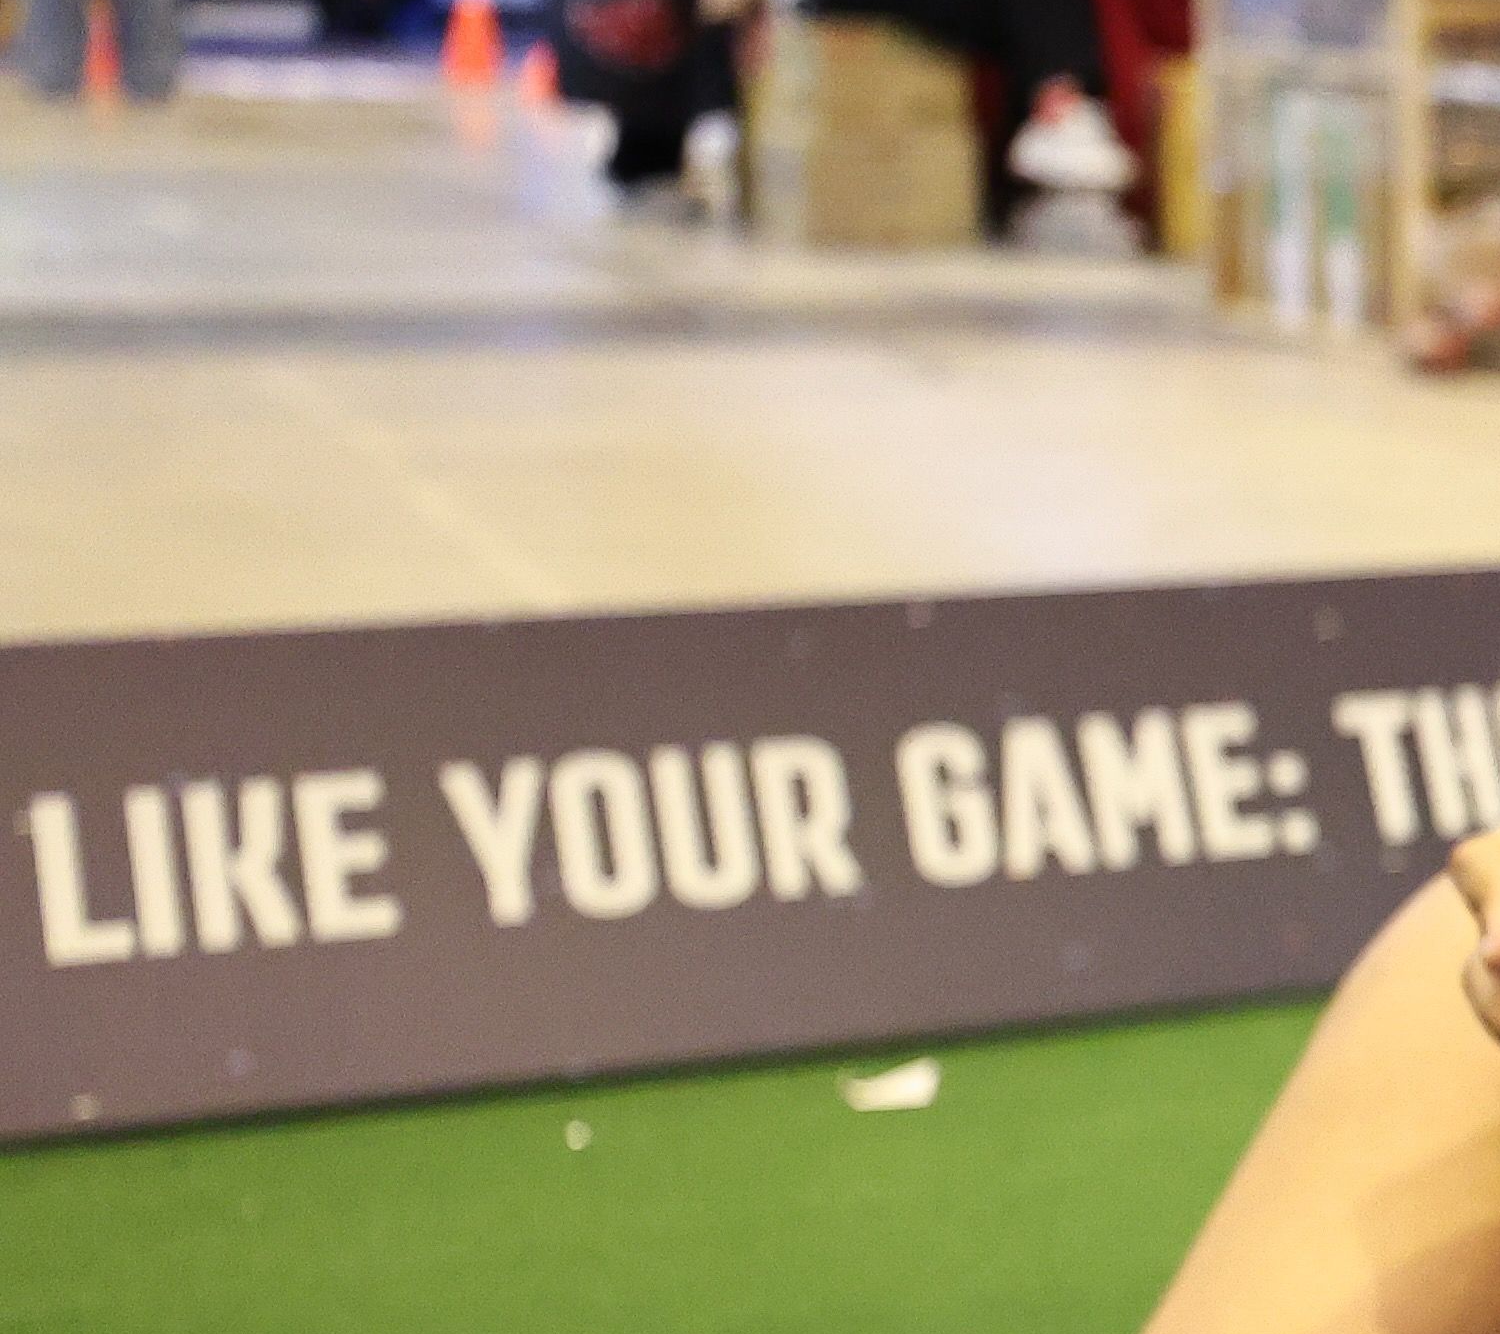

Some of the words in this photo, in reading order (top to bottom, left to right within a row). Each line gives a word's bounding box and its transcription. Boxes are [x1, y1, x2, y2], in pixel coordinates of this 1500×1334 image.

[28, 771, 404, 967] LIKE
[438, 737, 862, 925] YOUR
[895, 701, 1318, 884] GAME:
